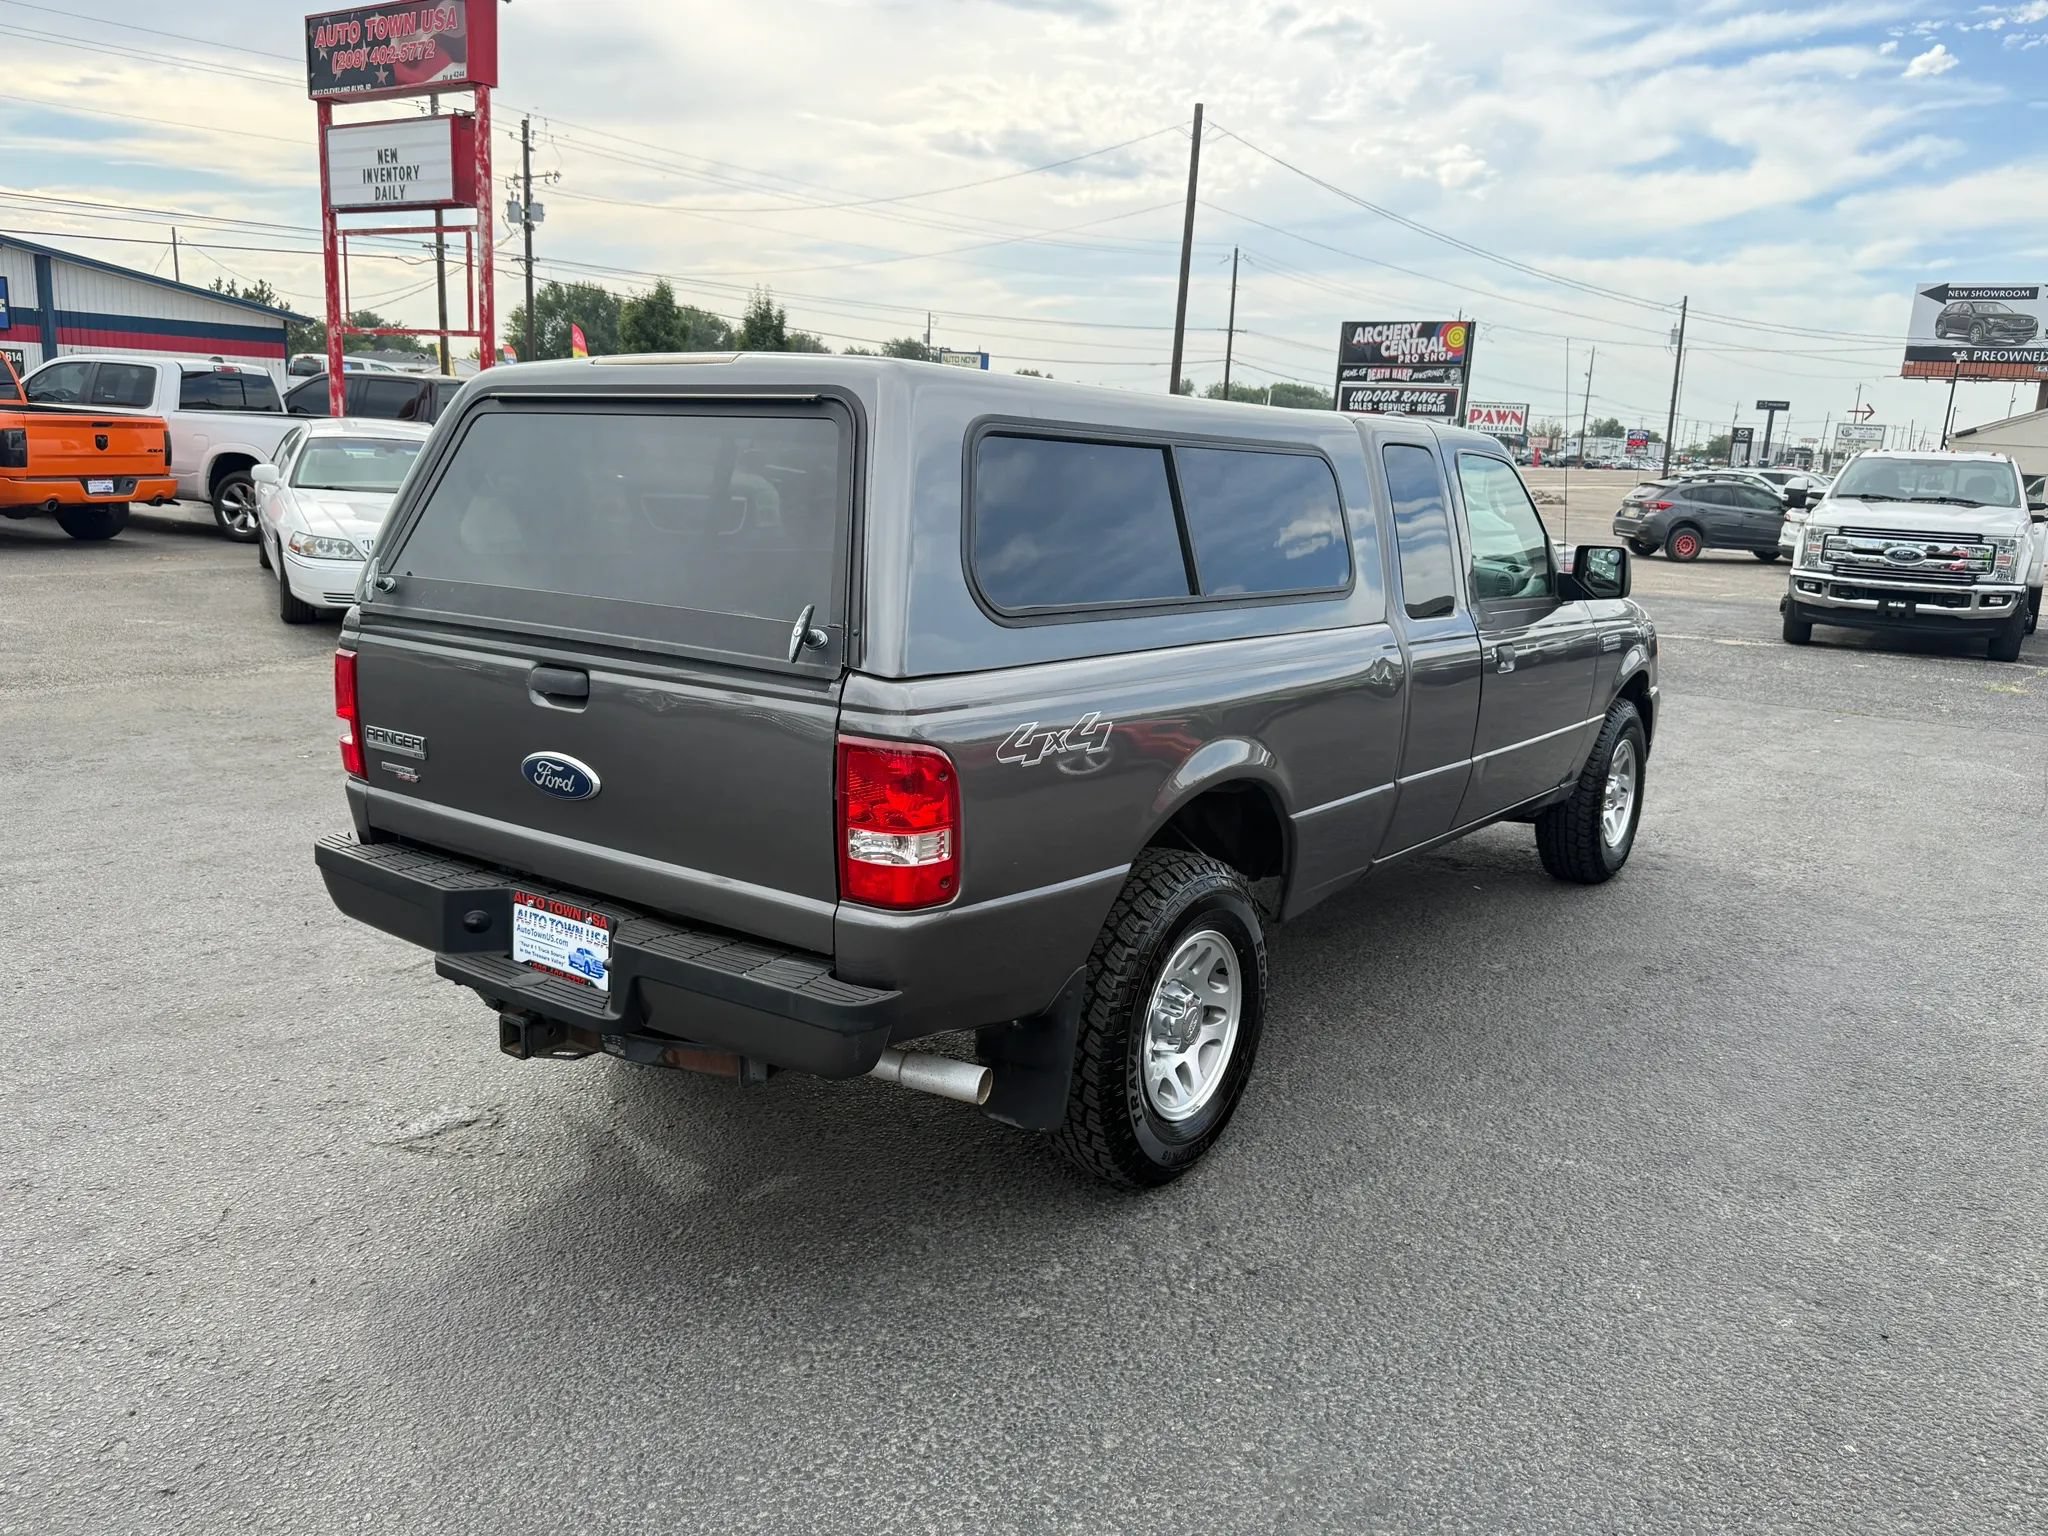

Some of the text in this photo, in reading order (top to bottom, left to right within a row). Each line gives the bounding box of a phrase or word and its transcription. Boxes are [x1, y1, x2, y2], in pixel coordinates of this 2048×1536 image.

[314, 8, 458, 48] AUTO TOWN USA
[332, 39, 436, 74] (208) 402-5772
[323, 86, 350, 95] CLEVELAND
[377, 148, 398, 165] NEW
[362, 165, 420, 184] INVENTORY
[375, 185, 406, 201] DAILY
[1971, 289, 2030, 297] SHOWROOM
[1352, 323, 1422, 344] ARCHERY
[1381, 336, 1446, 358] CENTRAL
[1397, 352, 1453, 364] PRO SHOP
[1367, 368, 1391, 382] DEATH
[1392, 368, 1413, 382] HARP
[1349, 390, 1447, 404] INDOOR RANGE
[1349, 402, 1446, 413] SALES SERVICE REPAIR
[1468, 409, 1524, 426] PAWN
[366, 727, 422, 751] RANGER
[996, 711, 1113, 767] 4x4
[534, 761, 575, 793] Ford
[513, 891, 545, 909] AUTO
[548, 901, 581, 920] TOWN
[515, 908, 609, 948] AUTO TOWN USA
[516, 925, 569, 947] AutoTownUS.com
